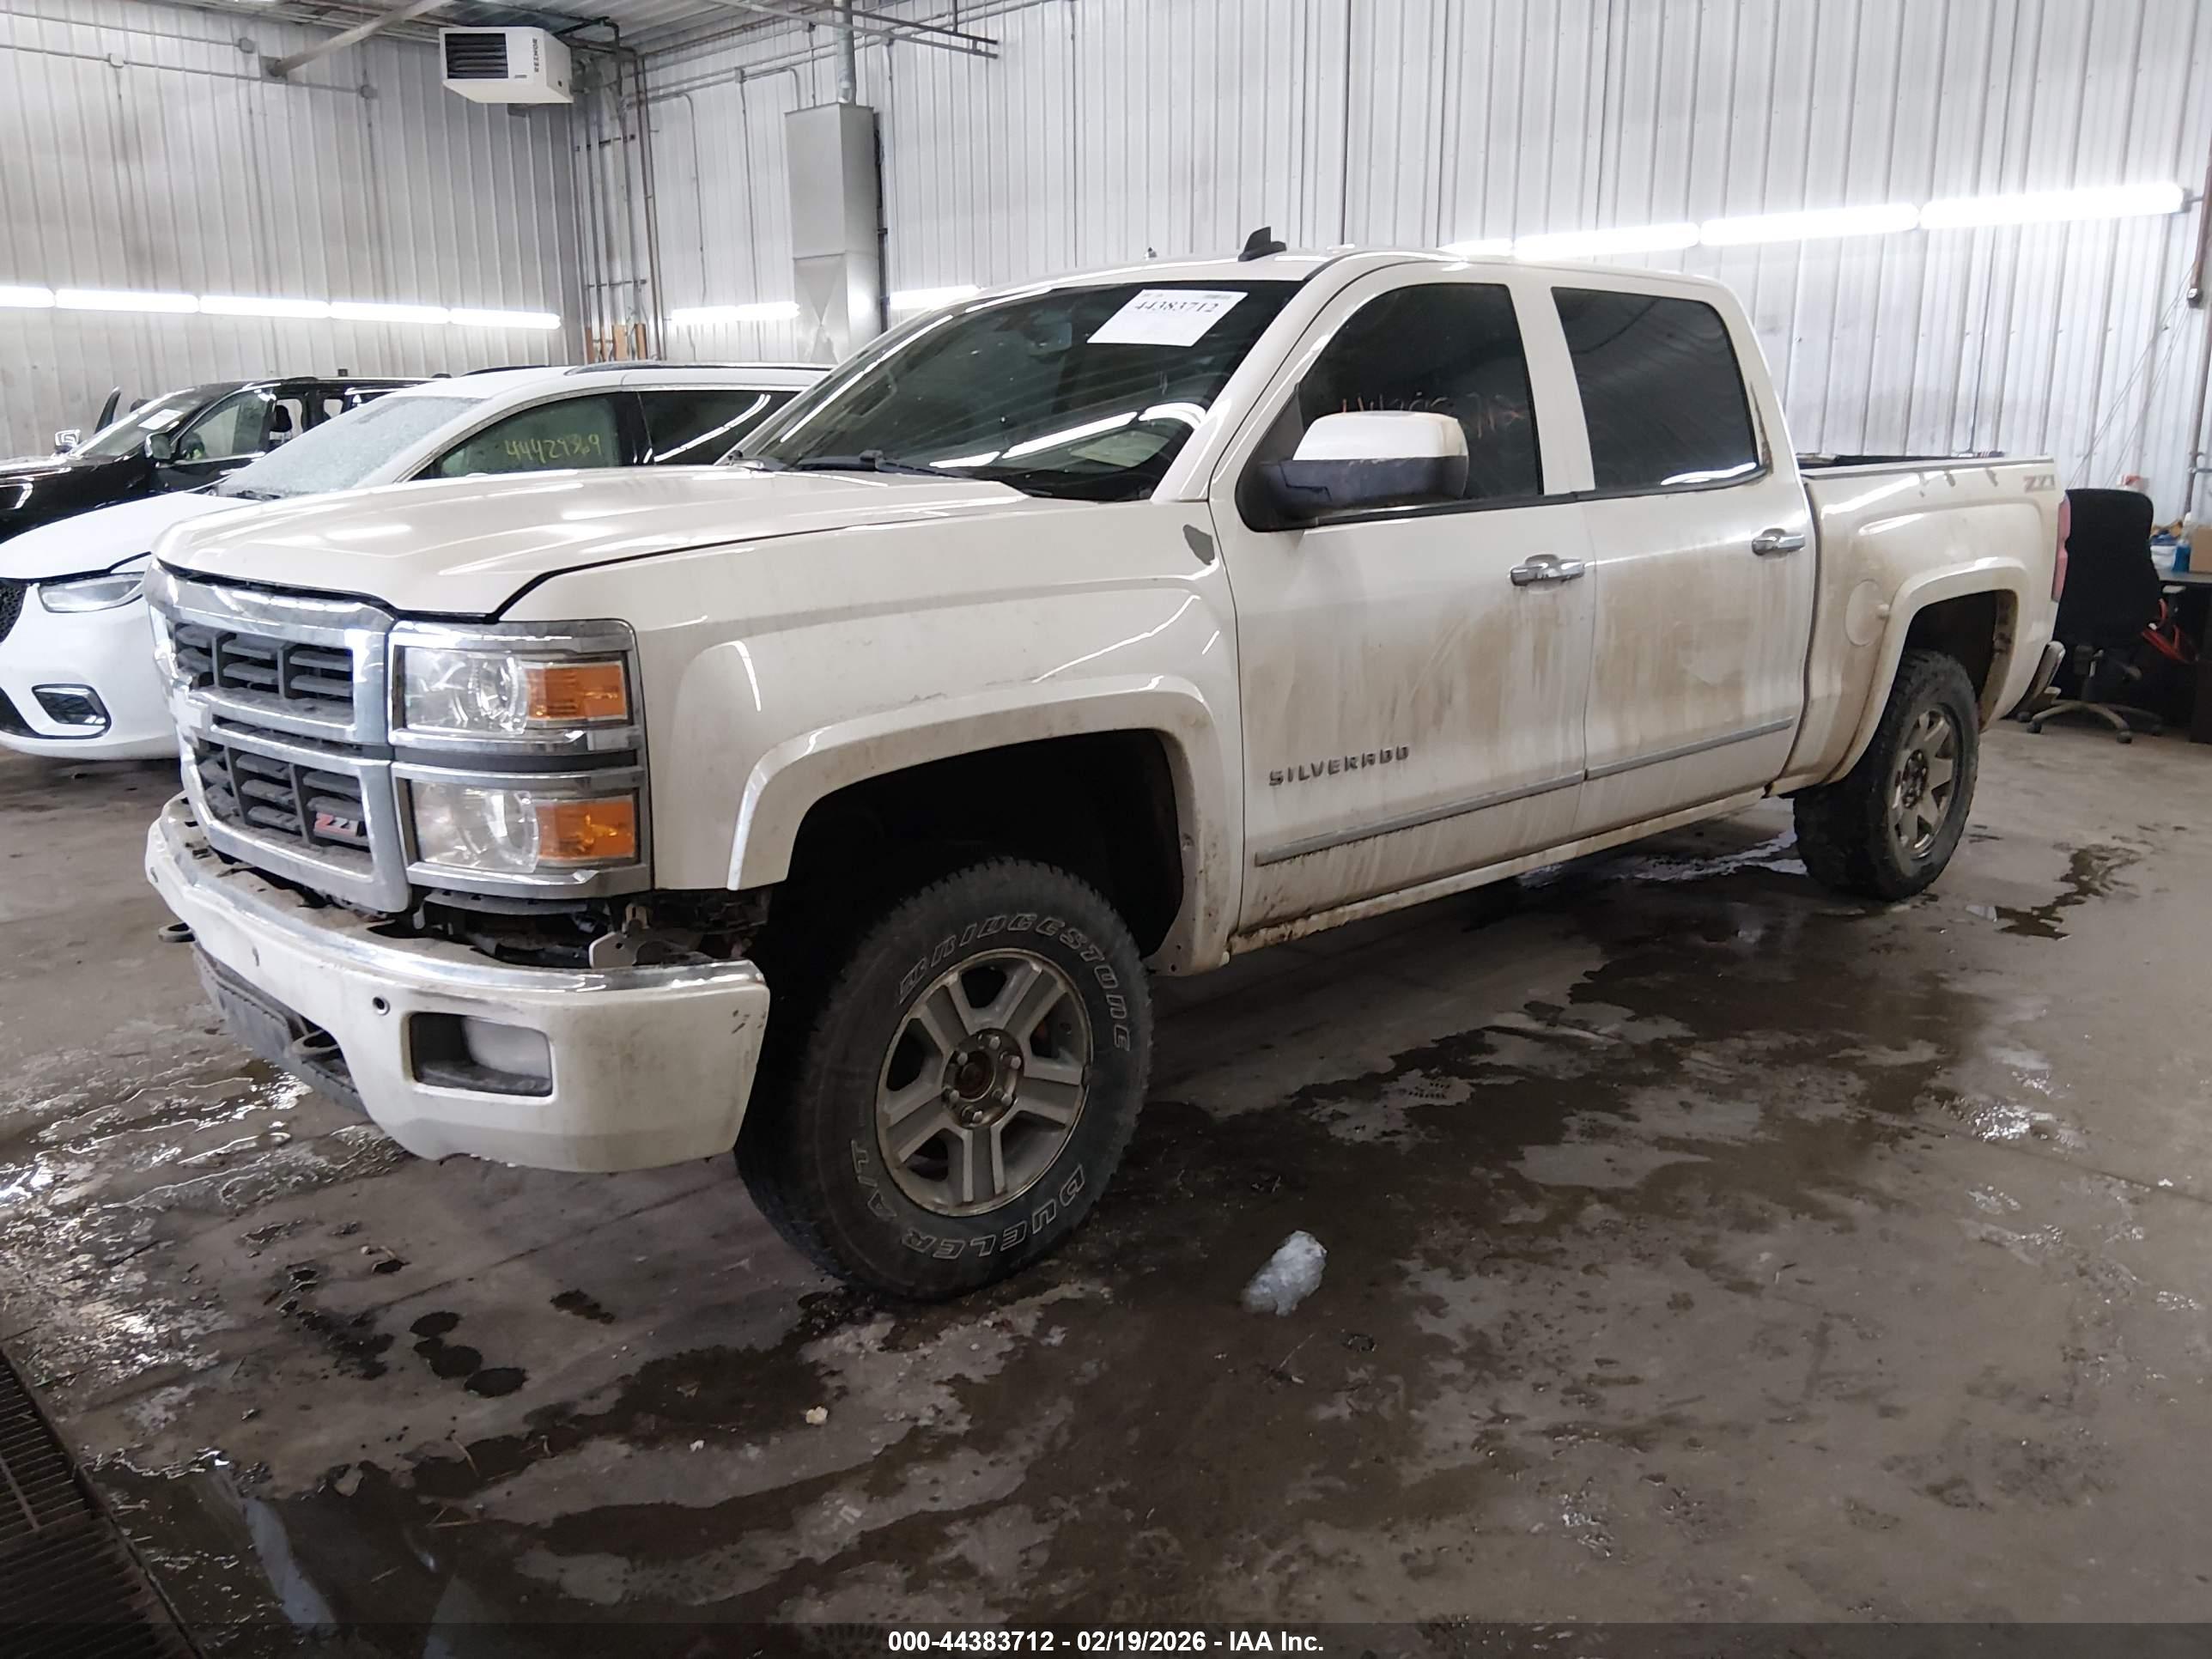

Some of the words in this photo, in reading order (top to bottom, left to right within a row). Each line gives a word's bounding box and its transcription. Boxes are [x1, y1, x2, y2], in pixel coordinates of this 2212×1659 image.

[1134, 301, 1220, 313] 44383712
[1269, 745, 1409, 787] SILVERADO
[313, 812, 359, 836] Z71
[899, 913, 1131, 1053] BRIDGESTONE
[851, 1139, 897, 1218] A/T
[902, 1164, 1085, 1260] DUELER
